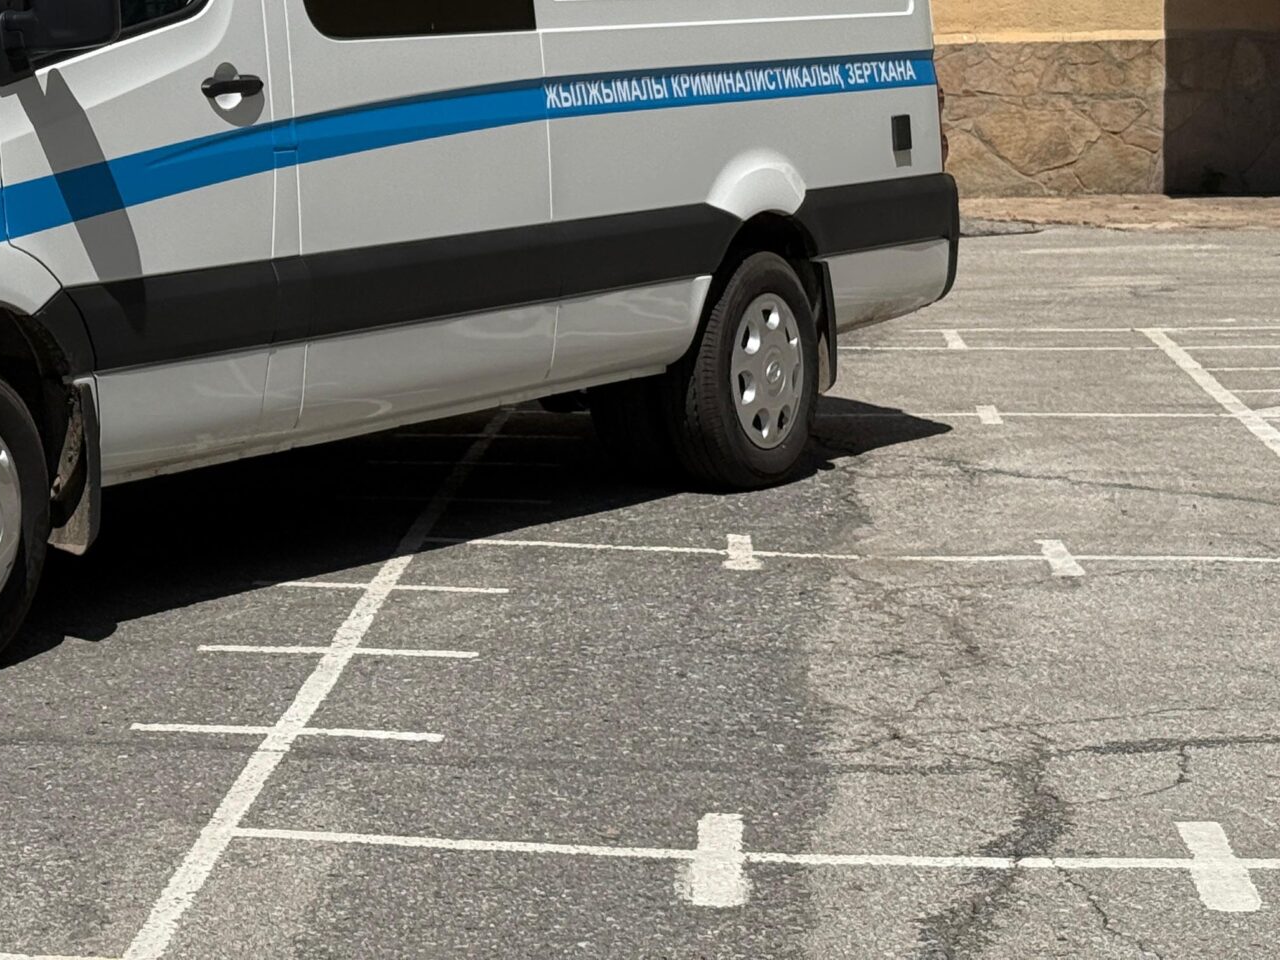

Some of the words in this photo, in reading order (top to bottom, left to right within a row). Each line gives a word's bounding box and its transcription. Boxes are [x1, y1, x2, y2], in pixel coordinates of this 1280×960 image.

[545, 74, 669, 109] ЖЫЛЖЫМАЛЫ
[671, 66, 844, 98] КРИМИНАЛИСТИКАЛЫҚ
[847, 59, 916, 85] ЗЕРТХАНА
